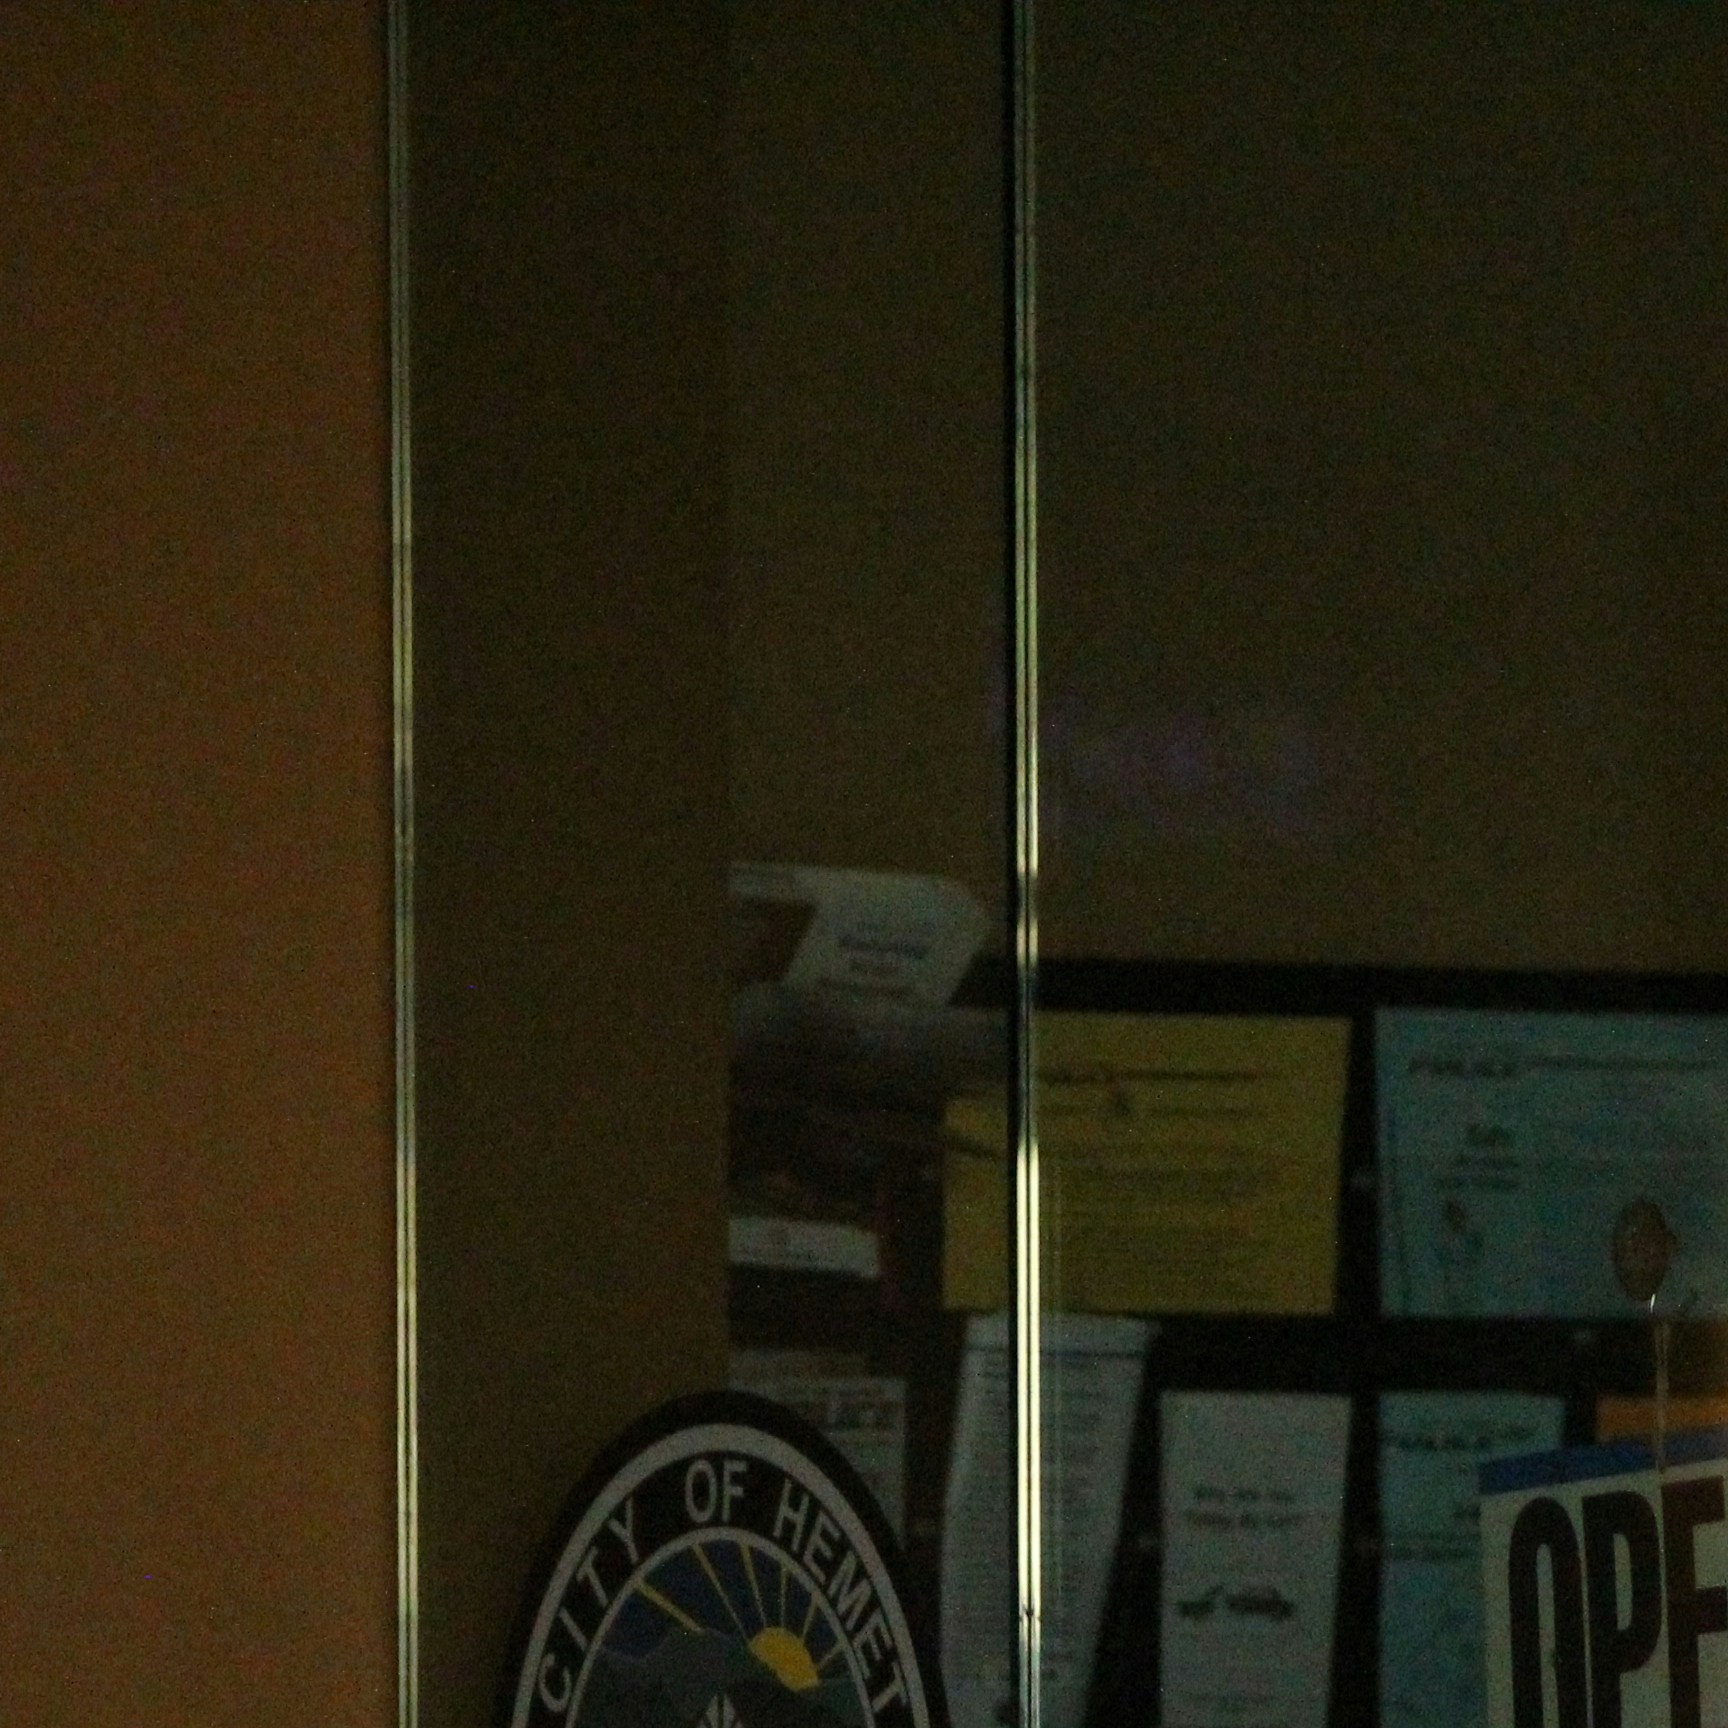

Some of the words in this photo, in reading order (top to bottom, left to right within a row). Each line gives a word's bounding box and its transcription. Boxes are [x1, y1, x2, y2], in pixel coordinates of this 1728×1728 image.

[538, 1497, 640, 1714] CITY
[684, 1458, 750, 1523] OF
[772, 1477, 911, 1715] HEMET
